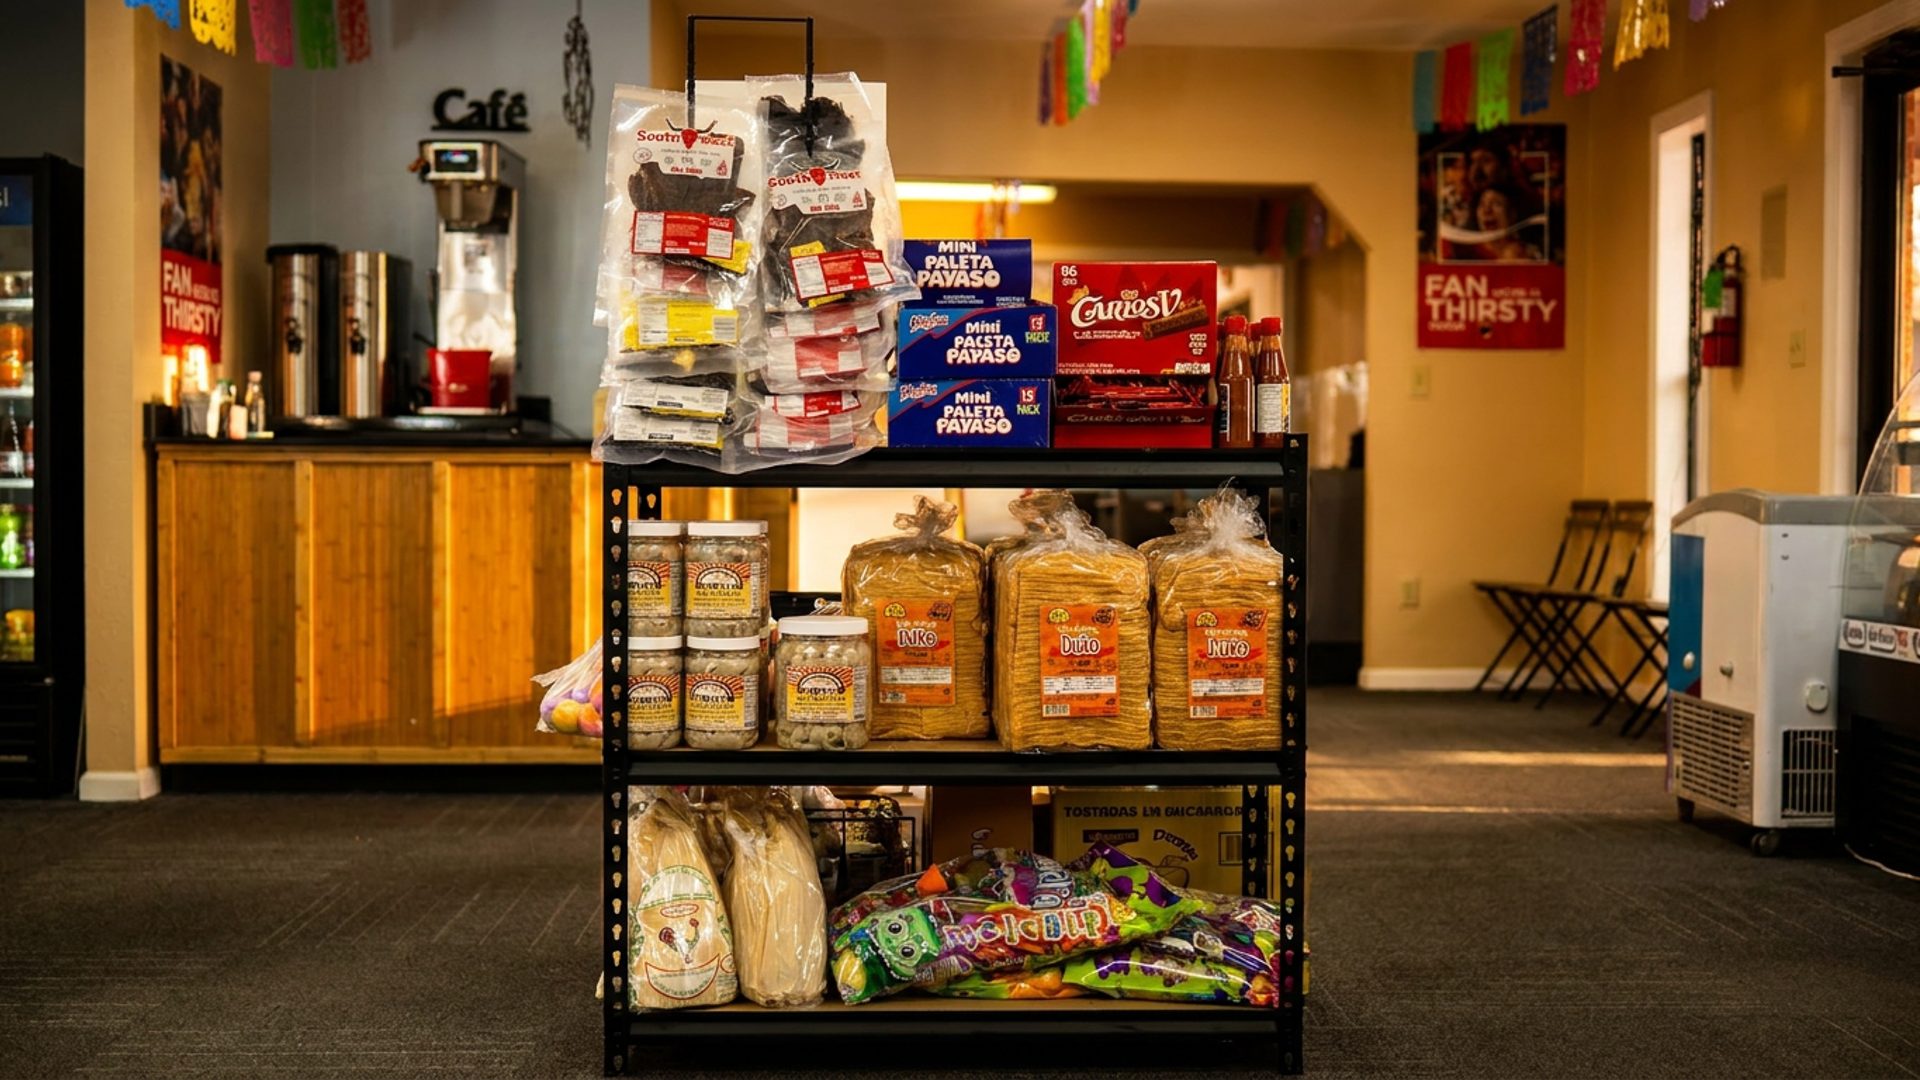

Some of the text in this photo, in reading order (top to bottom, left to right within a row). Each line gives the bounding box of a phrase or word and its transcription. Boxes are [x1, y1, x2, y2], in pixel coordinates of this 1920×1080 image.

[925, 255, 994, 269] PALETA
[163, 261, 192, 297] FAN
[917, 269, 1001, 288] PAYASO
[1425, 275, 1488, 298] FAN
[163, 295, 221, 337] THIRSTY
[1425, 299, 1557, 323] THIRSTY
[943, 405, 1005, 418] PALETA
[936, 418, 1012, 434] PAYASO
